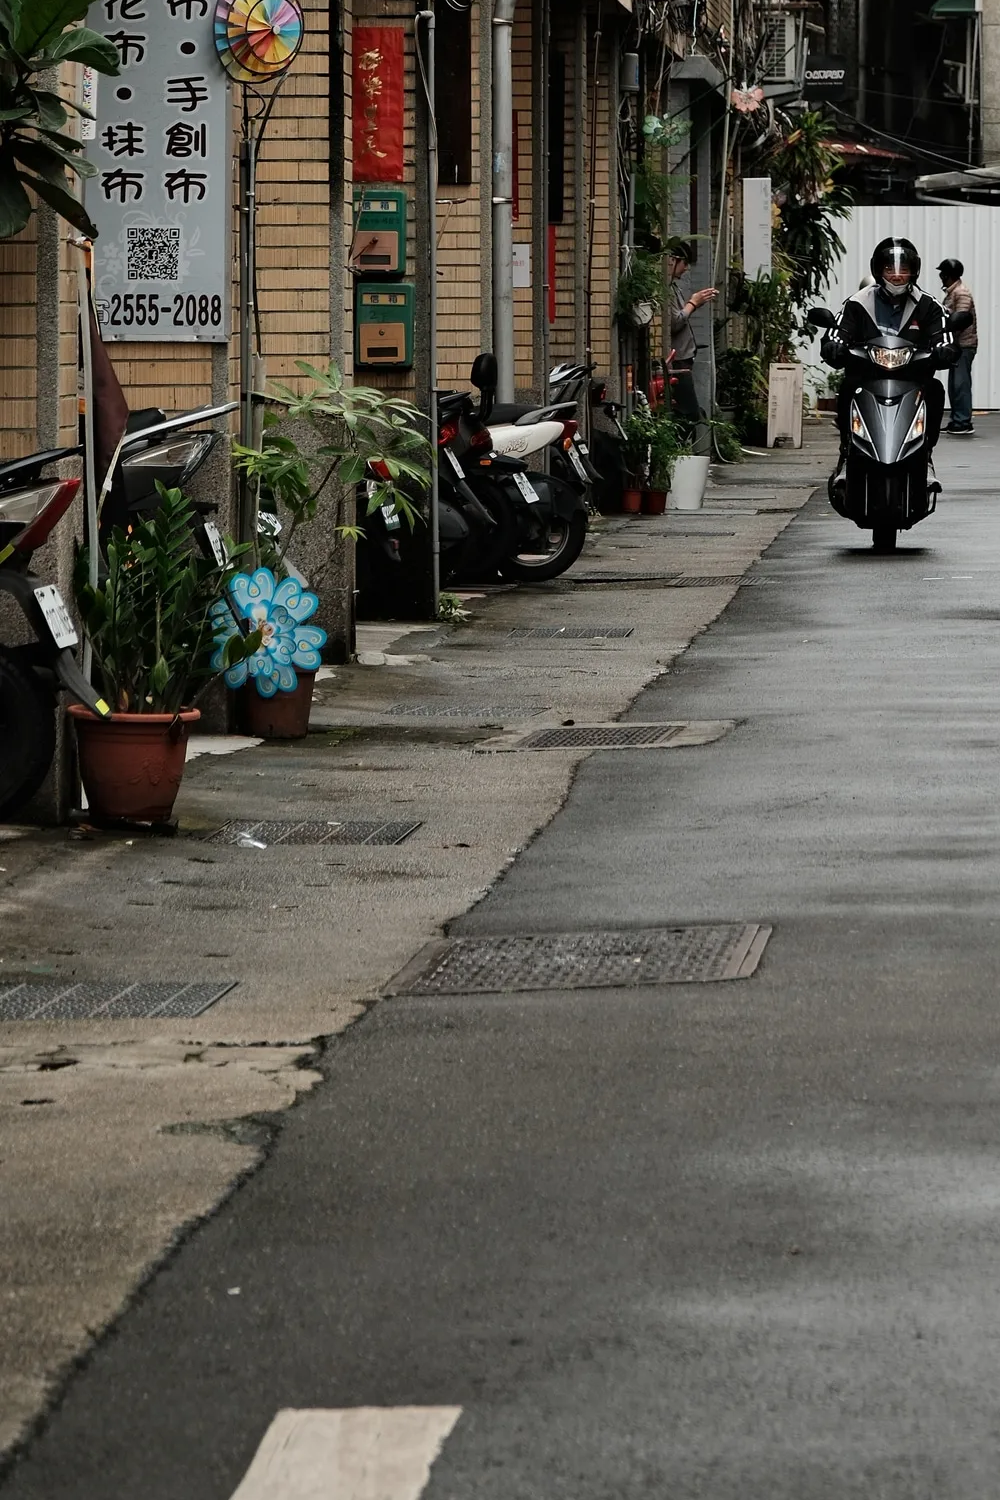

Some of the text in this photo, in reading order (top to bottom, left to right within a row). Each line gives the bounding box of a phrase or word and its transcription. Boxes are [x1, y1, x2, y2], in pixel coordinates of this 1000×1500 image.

[362, 201, 390, 210] 信箱
[370, 294, 398, 303] 信箱
[111, 294, 221, 326] 2555-2088
